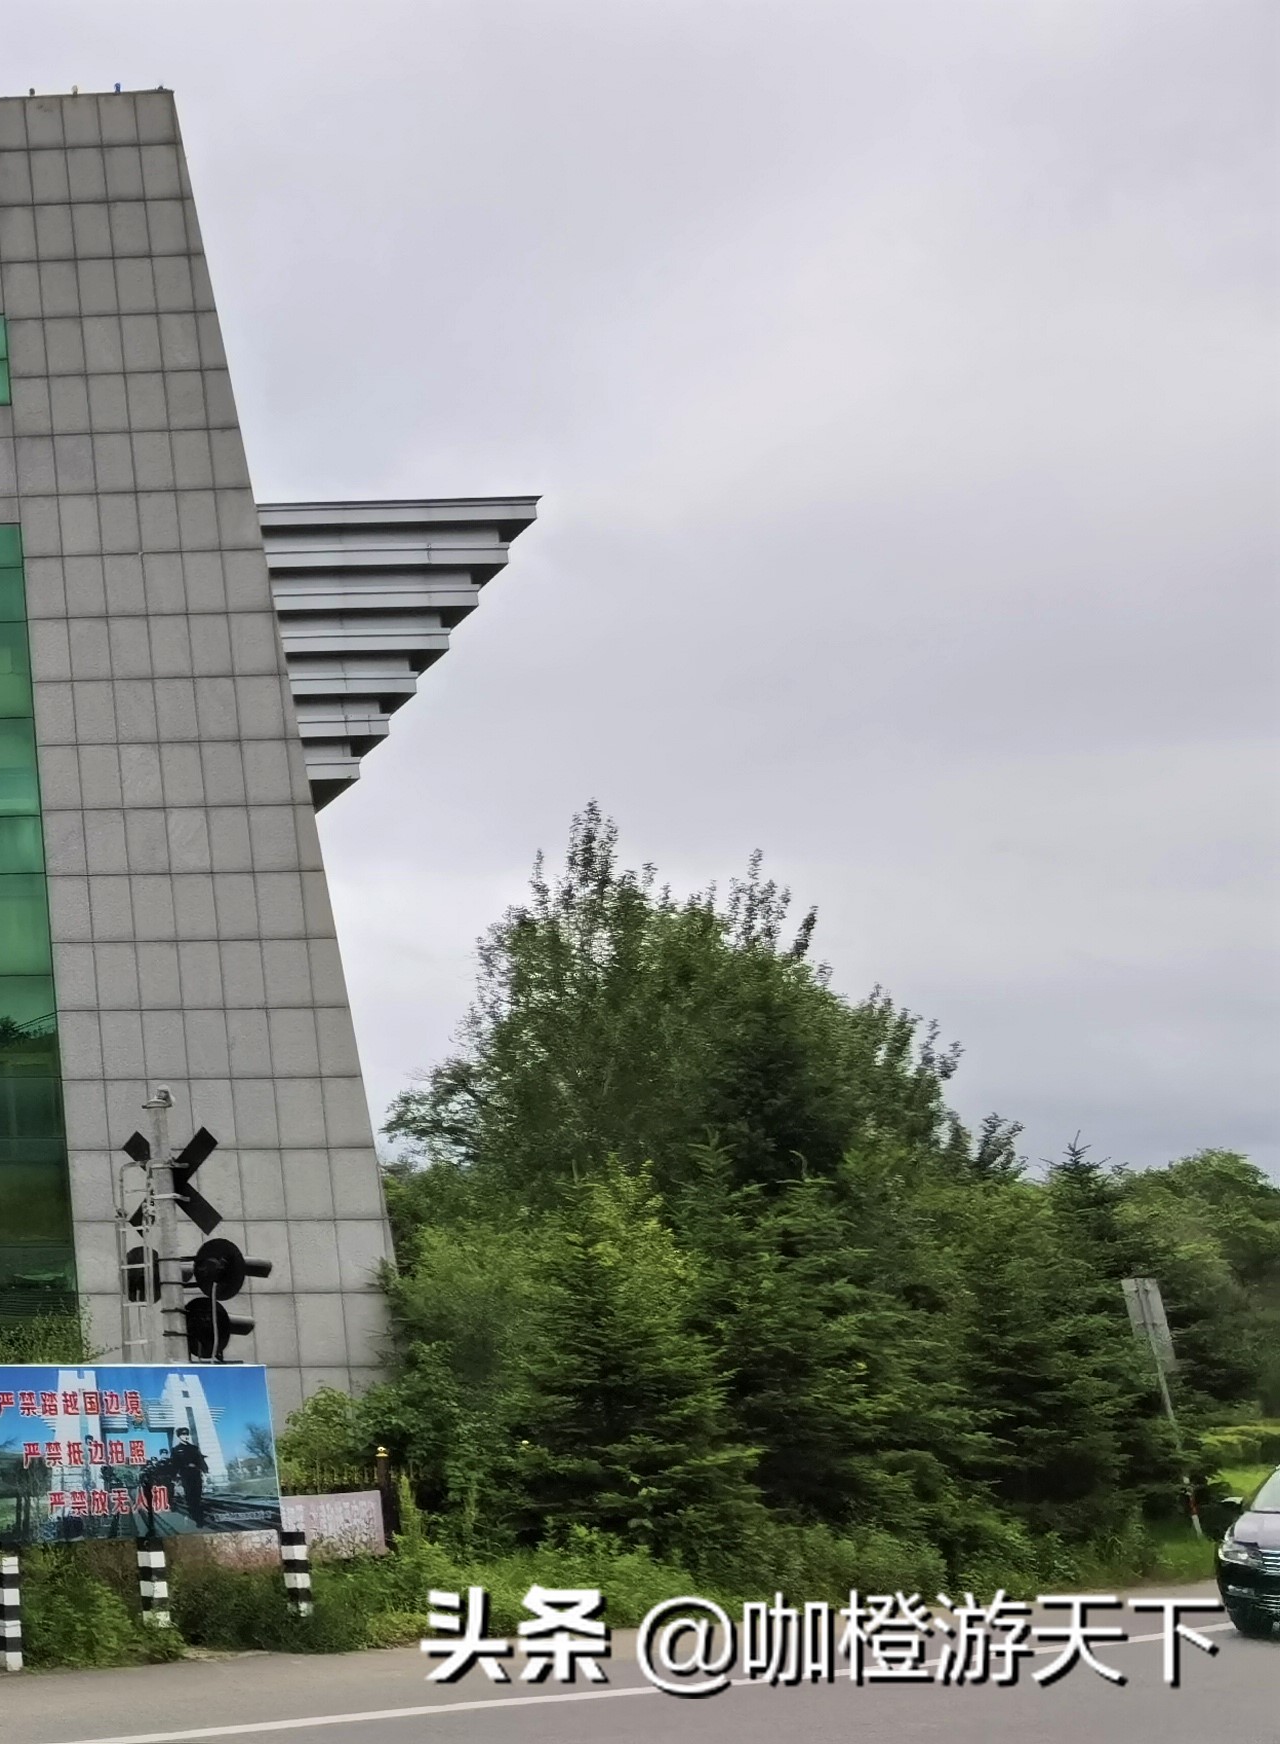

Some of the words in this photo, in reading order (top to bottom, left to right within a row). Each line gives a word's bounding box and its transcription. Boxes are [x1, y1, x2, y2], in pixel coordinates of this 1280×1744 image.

[22, 1440, 147, 1468] 严禁抵边拍照
[48, 1486, 171, 1516] 严禁放无人机
